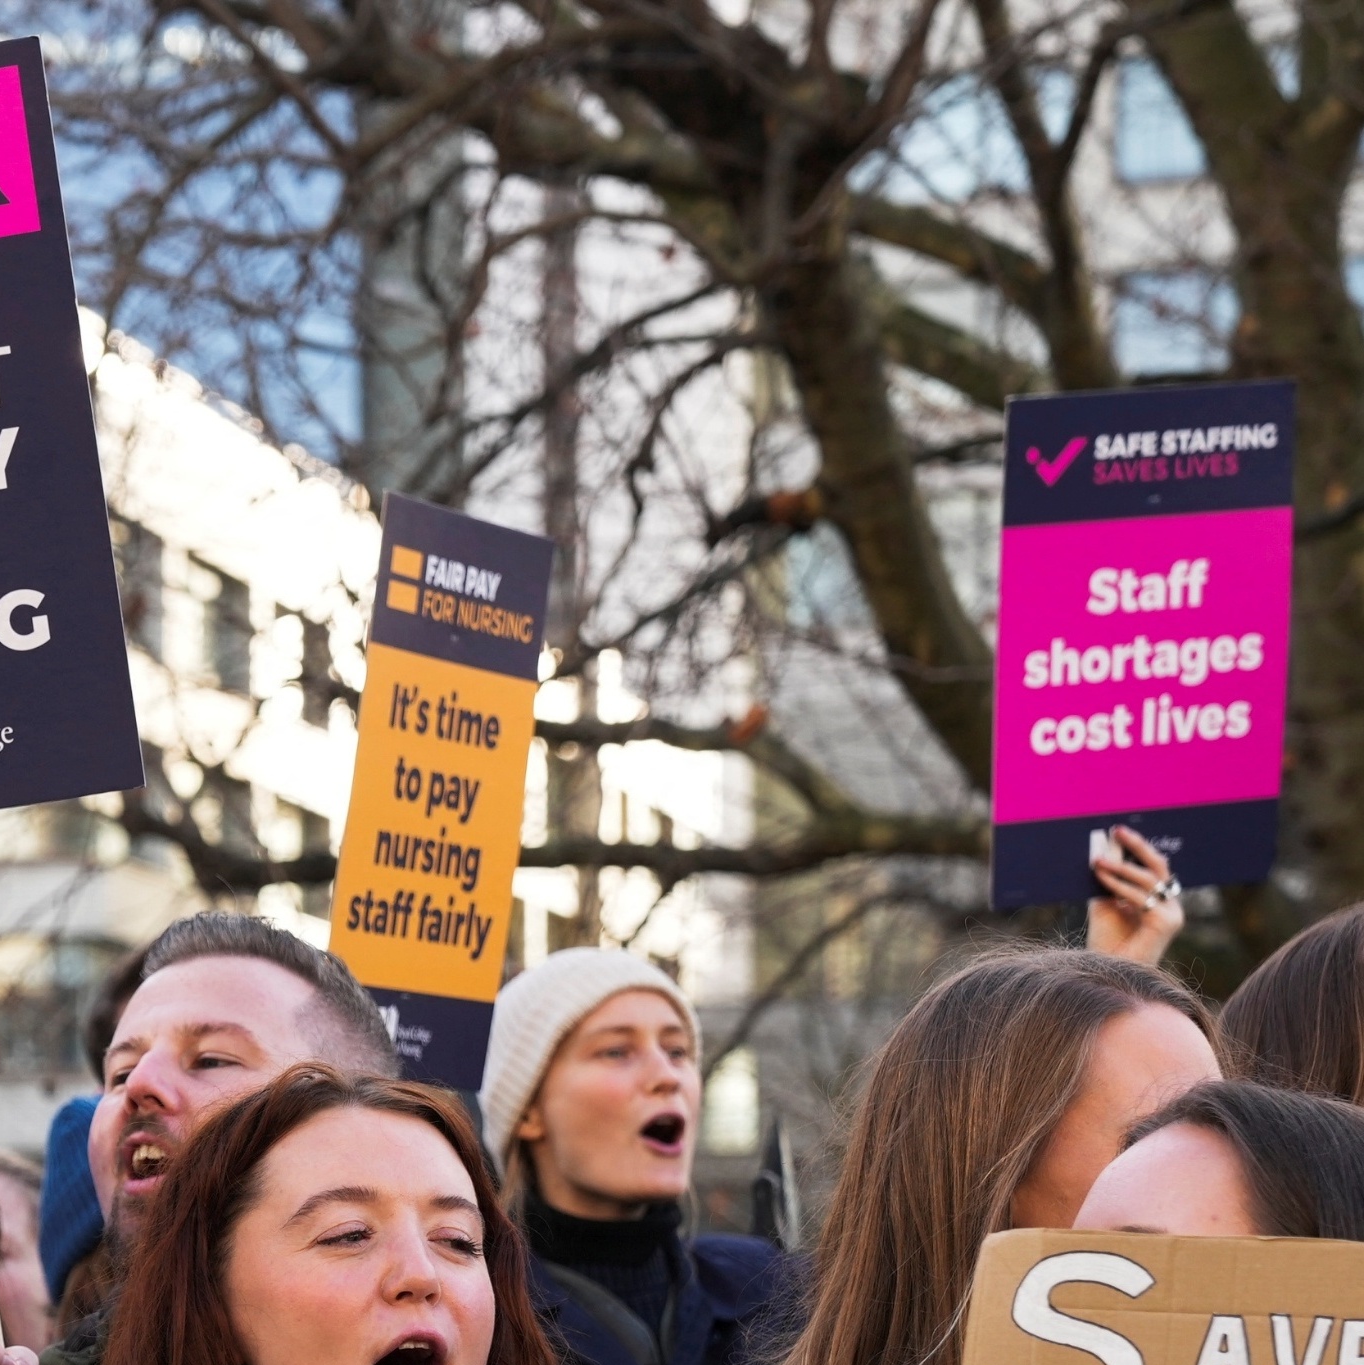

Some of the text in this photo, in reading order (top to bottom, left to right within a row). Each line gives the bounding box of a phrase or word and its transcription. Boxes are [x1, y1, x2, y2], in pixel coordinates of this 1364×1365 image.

[1092, 451, 1240, 485] SAVES LIVES
[1093, 421, 1279, 461] SAFE STAFFING
[424, 554, 502, 602] FAIR PAY
[1085, 557, 1211, 616] Staff
[422, 589, 535, 645] FOR NURSING
[1023, 632, 1265, 689] shortages
[389, 682, 501, 750] It's time
[1029, 692, 1253, 756] cost lives
[393, 756, 481, 825] to pay
[373, 826, 482, 893] nursing
[346, 889, 493, 961] staff fairly
